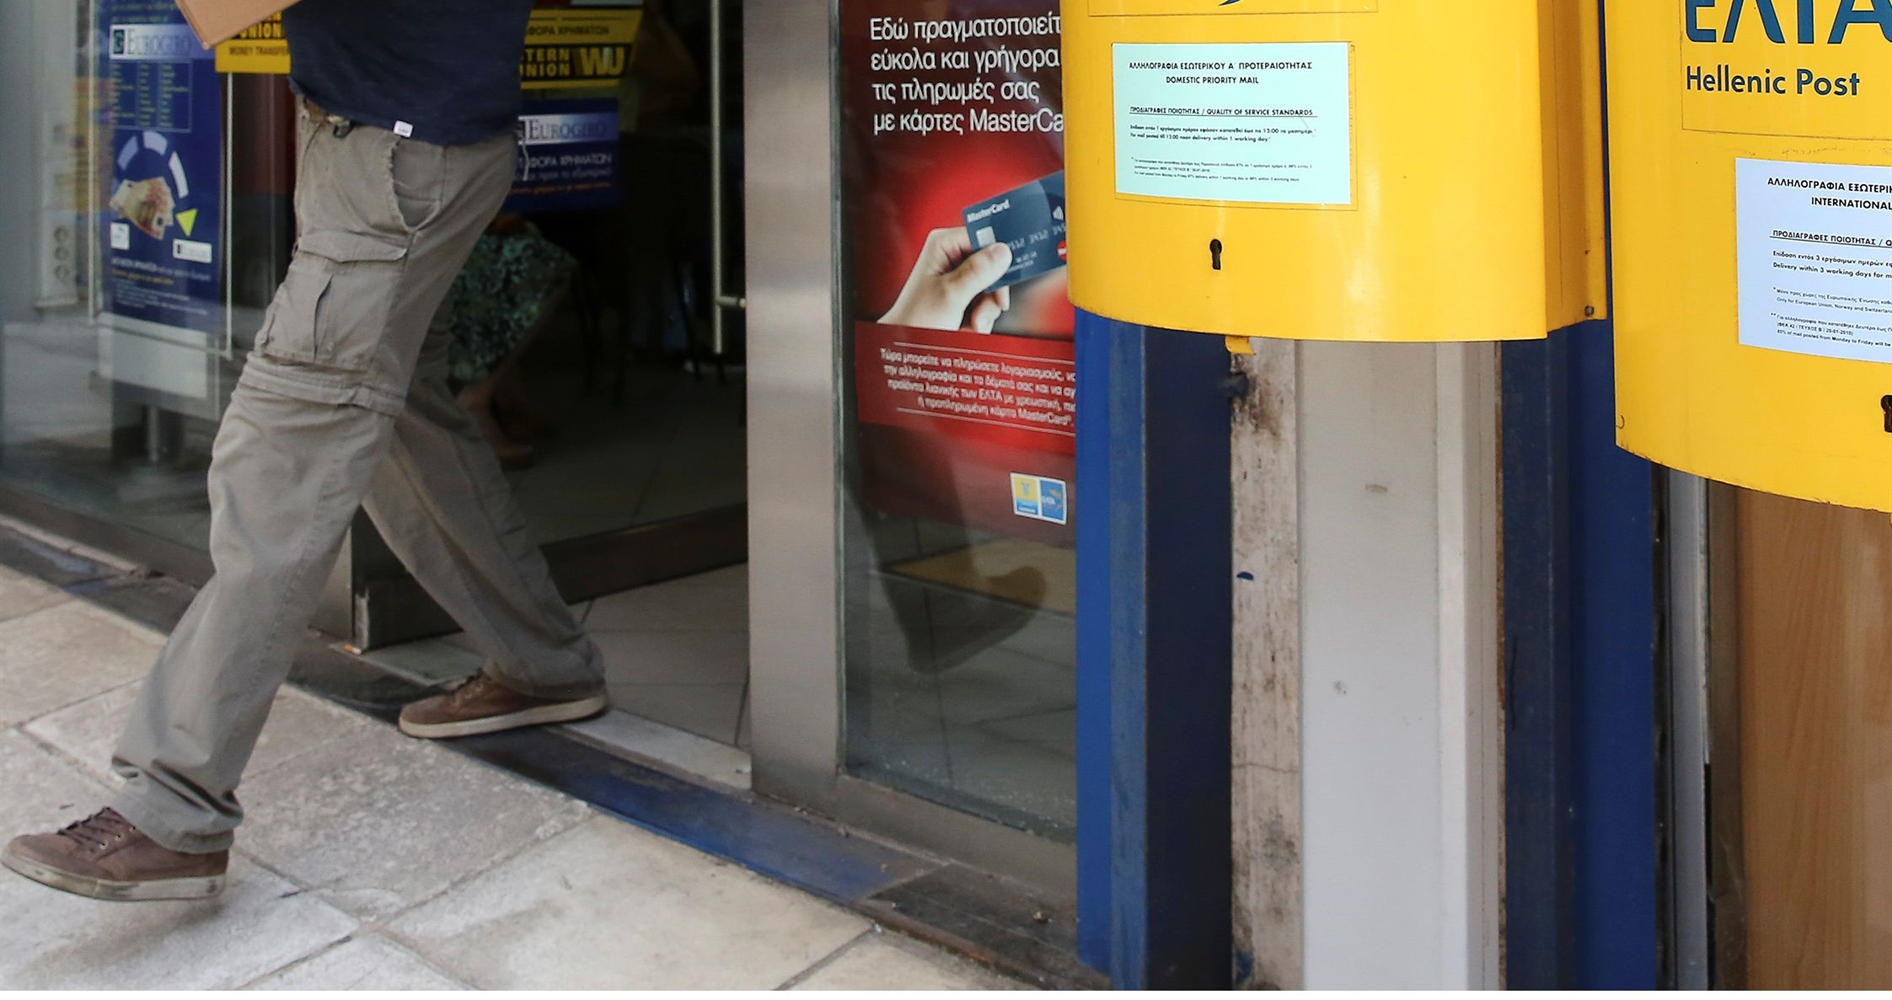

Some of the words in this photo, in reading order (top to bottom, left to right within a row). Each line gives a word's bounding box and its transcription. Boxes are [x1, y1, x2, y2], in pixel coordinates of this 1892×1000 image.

[869, 16, 909, 41] Εδώ
[870, 47, 937, 71] εύκολα
[940, 50, 970, 69] και
[974, 44, 1061, 74] γρήγορα
[1129, 62, 1178, 70] ΑΛΛΗΛΟΓΡΑΦΙΑ
[1180, 62, 1226, 70] ΕΣΩΤΕΡΙΚΟΥ
[1238, 62, 1313, 70] ΠΡΟΤΕΡΑΙΟΤΗΤΑΣ
[1166, 76, 1201, 84] DOMESTIC
[1202, 76, 1237, 84] PRIORITY
[1686, 65, 1786, 95] Hellenic
[1796, 68, 1860, 97] Post
[871, 82, 897, 105] τις
[901, 77, 996, 106] πληρωμές
[1000, 80, 1041, 104] σας
[1130, 106, 1167, 114] ΠΡΟΔΙΑΓΡΑΦΕΣ
[1168, 107, 1200, 115] ΠΟΙΟΤΗΤΑΣ
[873, 113, 895, 136] με
[900, 108, 965, 137] κάρτες
[969, 107, 1064, 133] MasterCa
[1767, 177, 1845, 191] ΑΛΛΗΛΟΓΡΑΦΙΑ
[966, 198, 1010, 223] MasterCard
[1811, 197, 1892, 210] INTERNATIONAL
[1773, 230, 1829, 242] ΠΡΟΔΙΑΓΡΑΦΕΣ
[1830, 236, 1876, 245] ΠΟΙΟΤΗΤΑΣ
[1773, 250, 1797, 259] Επίδοση
[1798, 253, 1814, 261] εντός
[1821, 256, 1856, 265] εργάσιμων
[1858, 259, 1884, 267] ημερών
[1773, 262, 1797, 271] Delivery
[1826, 268, 1854, 277] working
[1855, 270, 1872, 278] days
[880, 347, 902, 362] Τώρα
[902, 353, 940, 366] μπορείτε
[940, 358, 952, 367] να
[883, 364, 898, 377] την
[898, 364, 958, 383] αλληλογραφία
[958, 374, 973, 383] και
[973, 375, 984, 383] τα
[1016, 381, 1034, 393] σας
[1034, 383, 1049, 394] και
[1049, 385, 1062, 396] να
[960, 387, 978, 399] των
[978, 388, 1004, 402] ΕΛΤΑ
[1003, 394, 1015, 405] με
